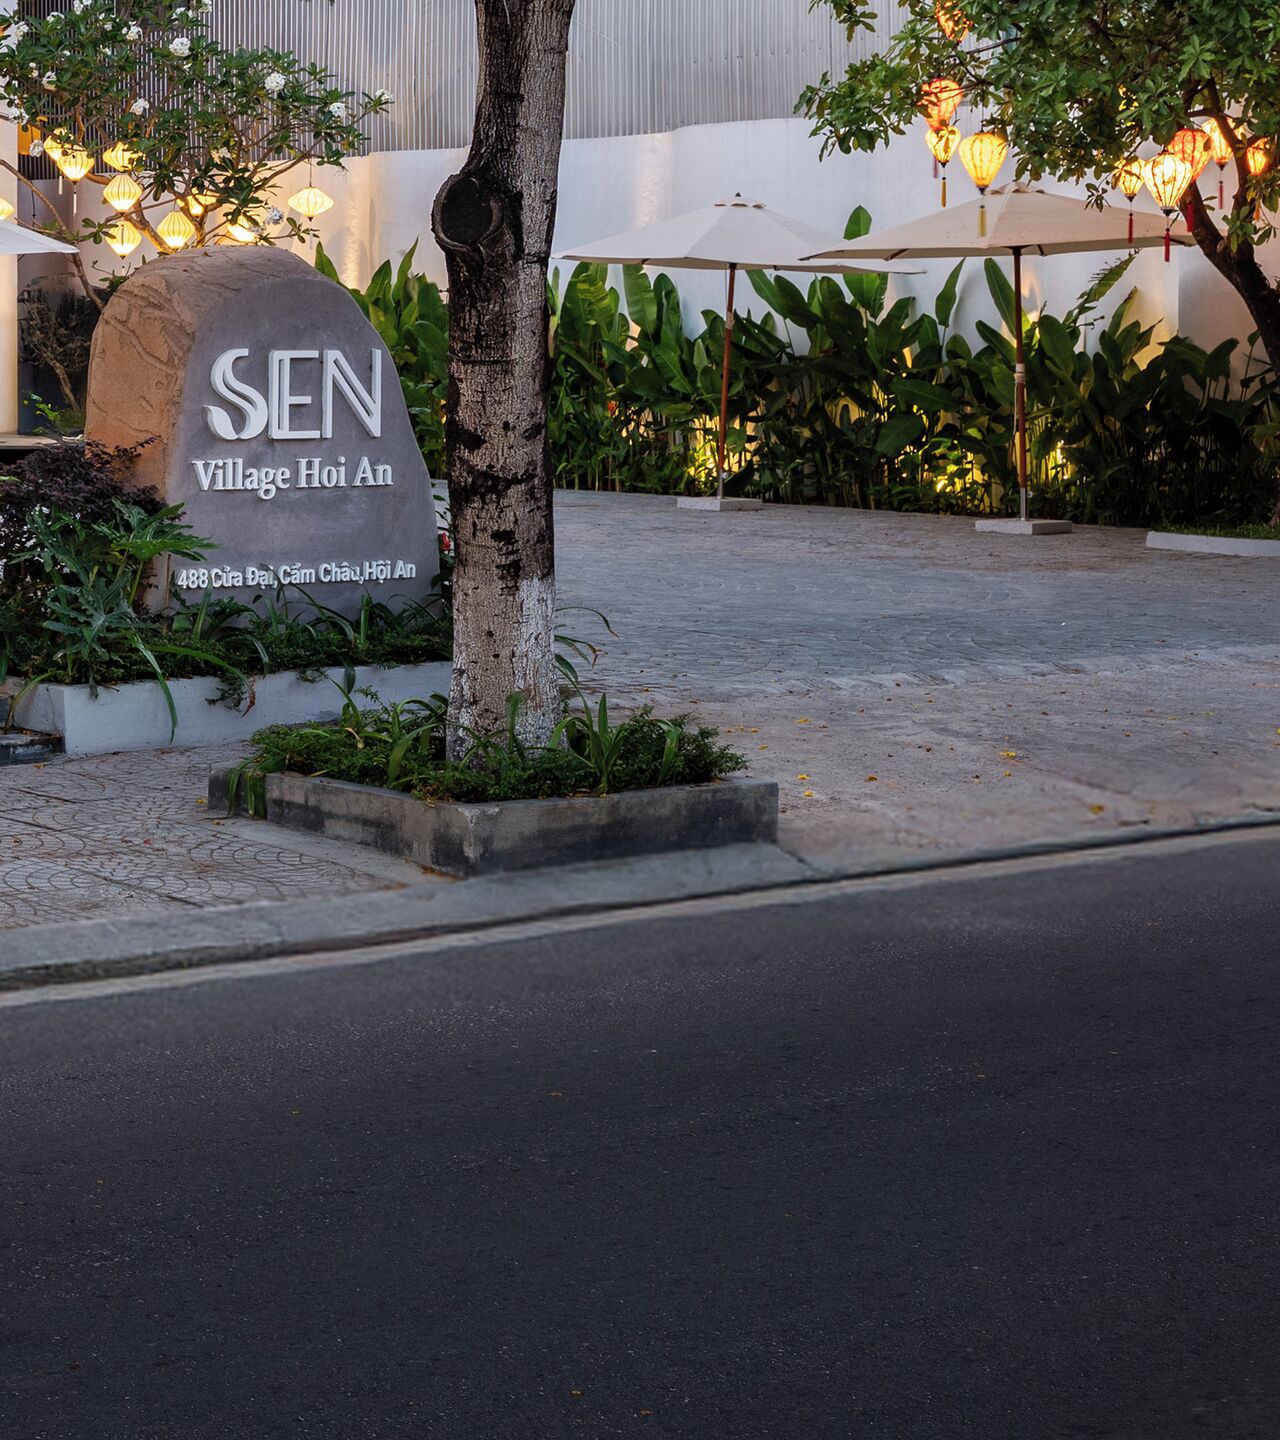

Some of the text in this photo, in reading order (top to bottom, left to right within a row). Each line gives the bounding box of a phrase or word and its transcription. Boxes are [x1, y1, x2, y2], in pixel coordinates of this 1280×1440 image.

[203, 348, 382, 440] SEN
[192, 456, 394, 500] Village Hoi An
[177, 568, 209, 589] 488
[392, 559, 417, 579] An
